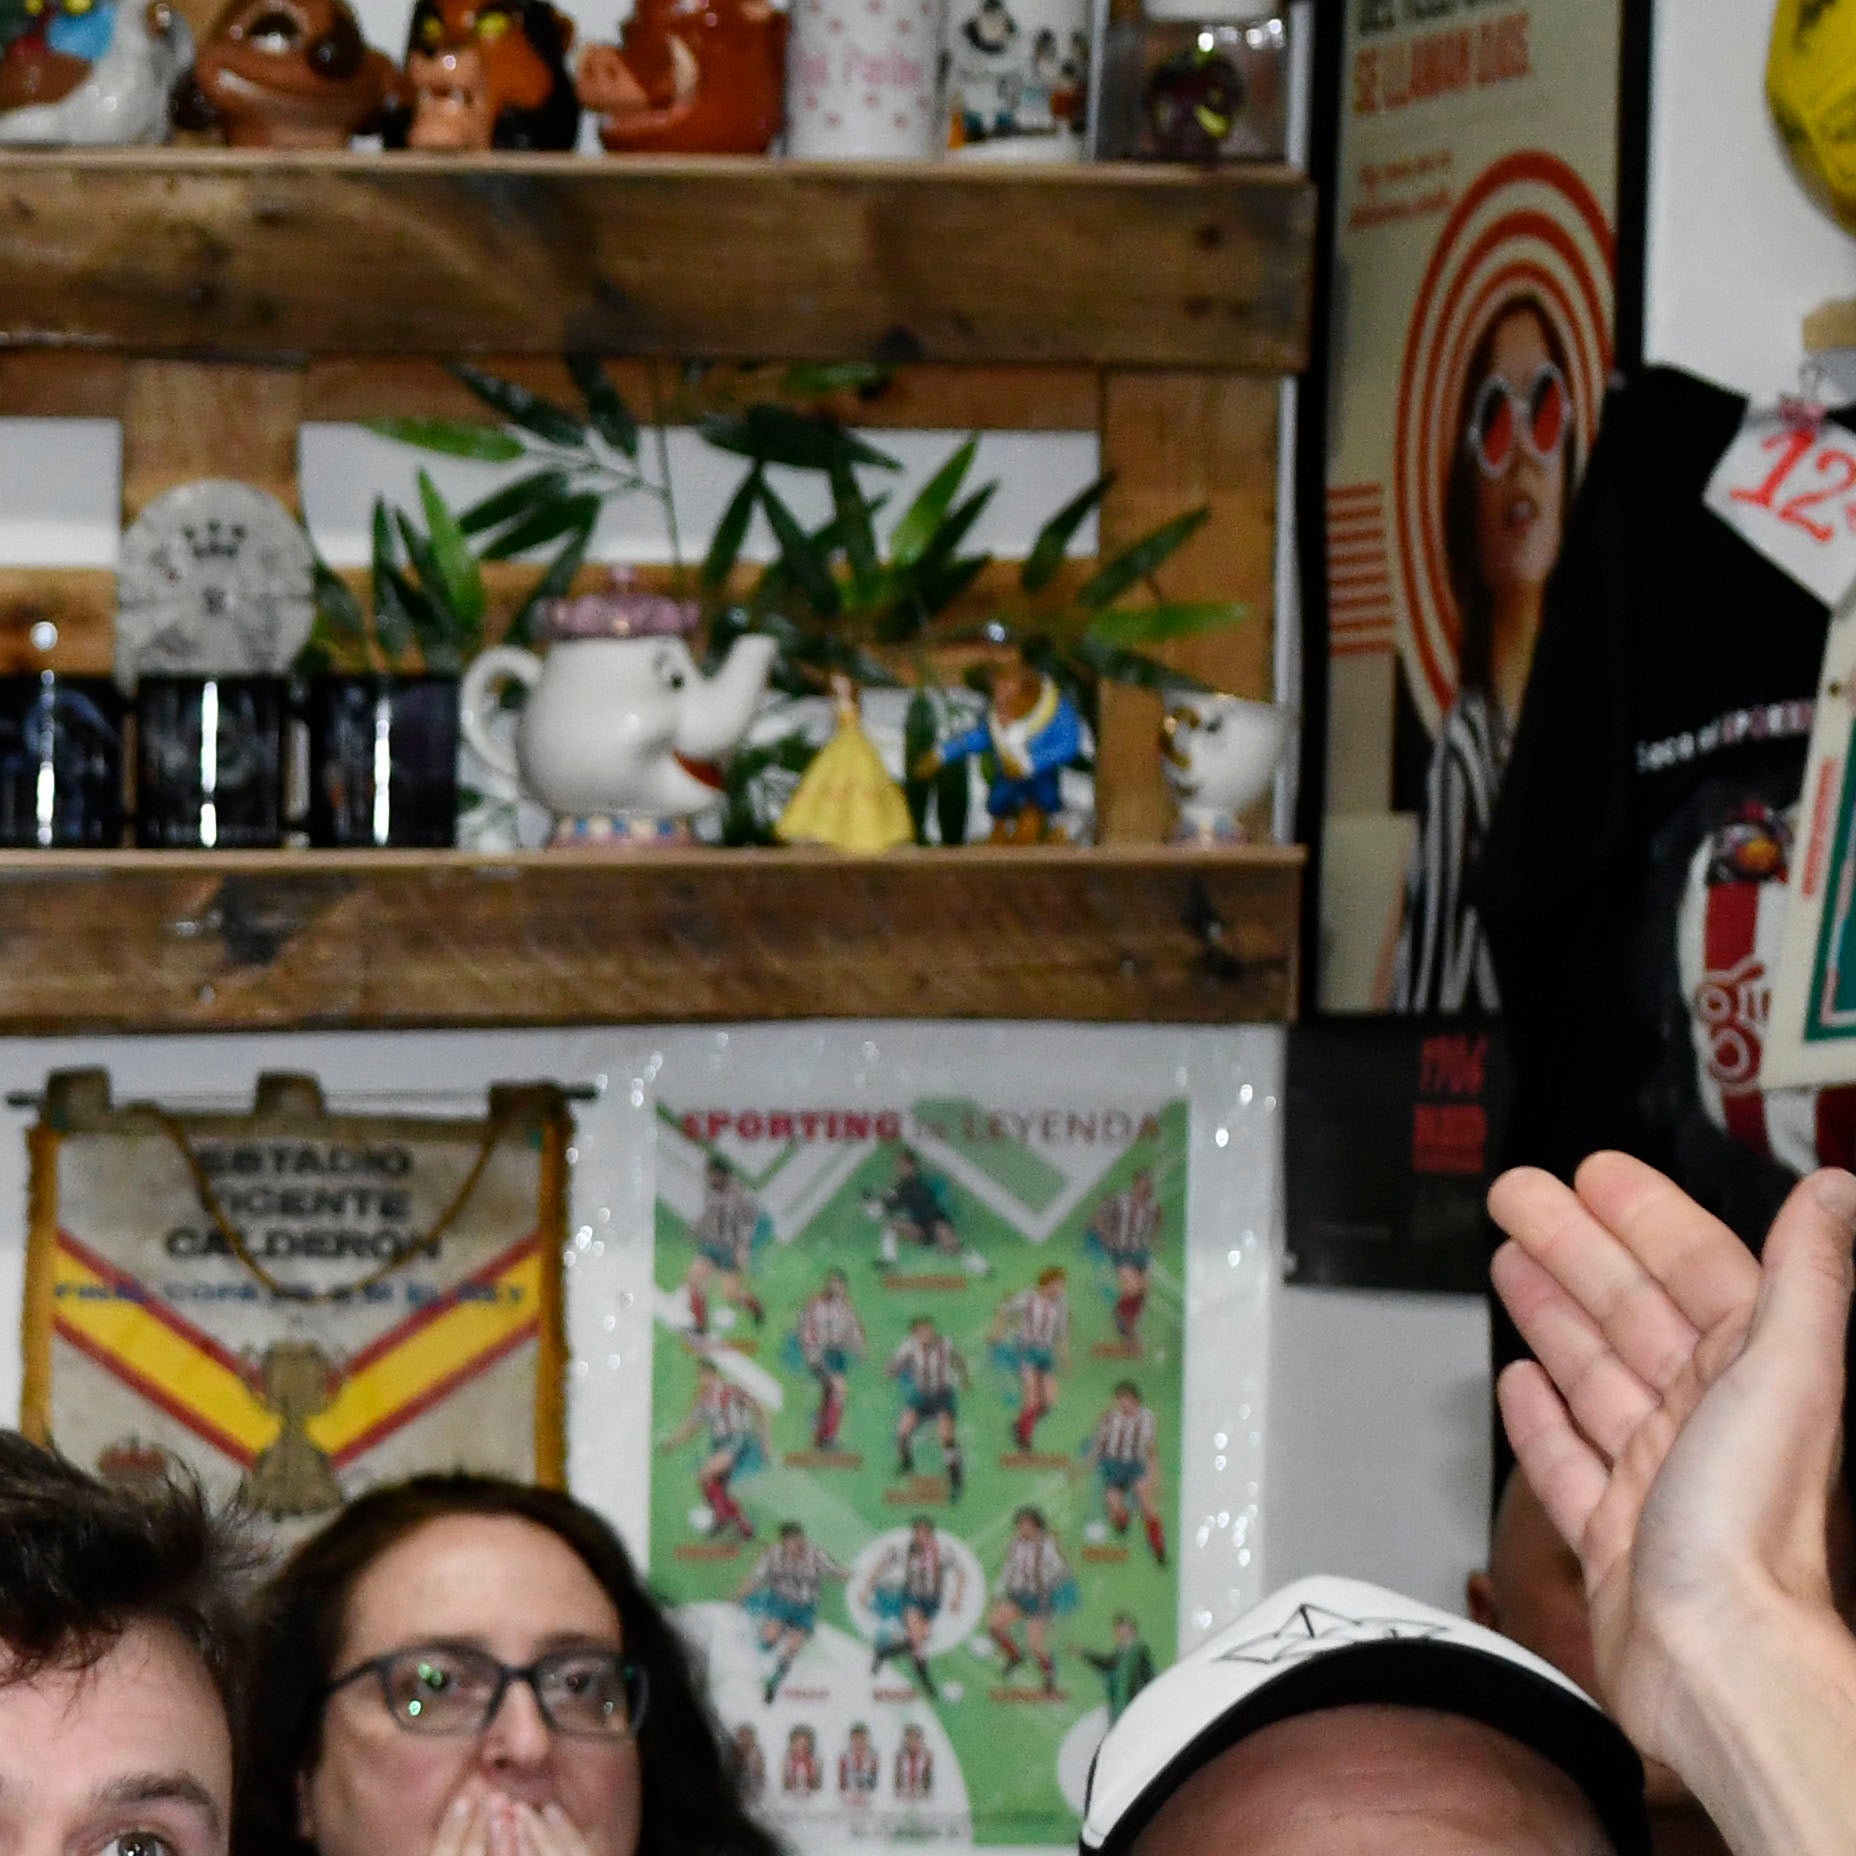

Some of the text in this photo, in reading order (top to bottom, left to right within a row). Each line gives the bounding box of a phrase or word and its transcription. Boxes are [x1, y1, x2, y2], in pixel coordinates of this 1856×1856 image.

[1729, 427, 1856, 542] 12
[684, 1109, 901, 1142] SPORTING
[197, 1143, 414, 1177] ESTADIO
